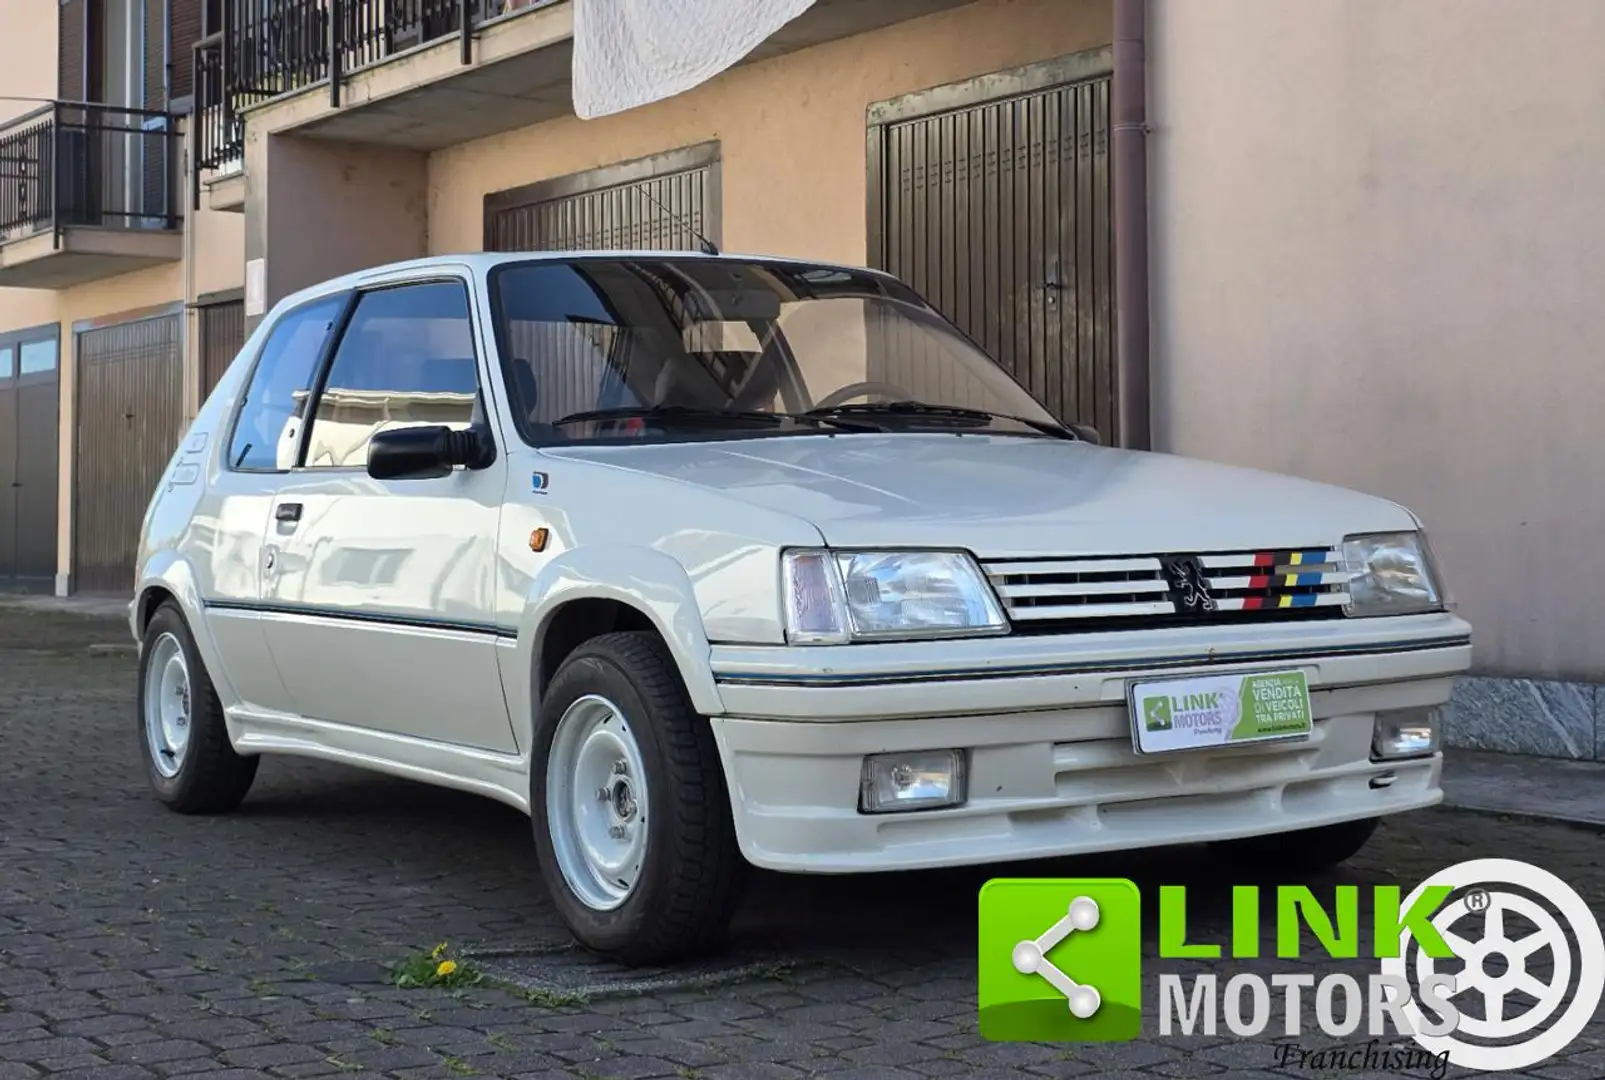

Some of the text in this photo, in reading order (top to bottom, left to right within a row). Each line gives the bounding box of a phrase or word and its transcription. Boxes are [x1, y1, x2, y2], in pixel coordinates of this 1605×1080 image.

[1252, 685, 1302, 700] VENDITA
[1171, 692, 1219, 712] LINK
[1254, 698, 1304, 714] DI VEICOLI
[1173, 711, 1223, 729] MOTORS
[1256, 711, 1305, 724] TRA PRIVATI
